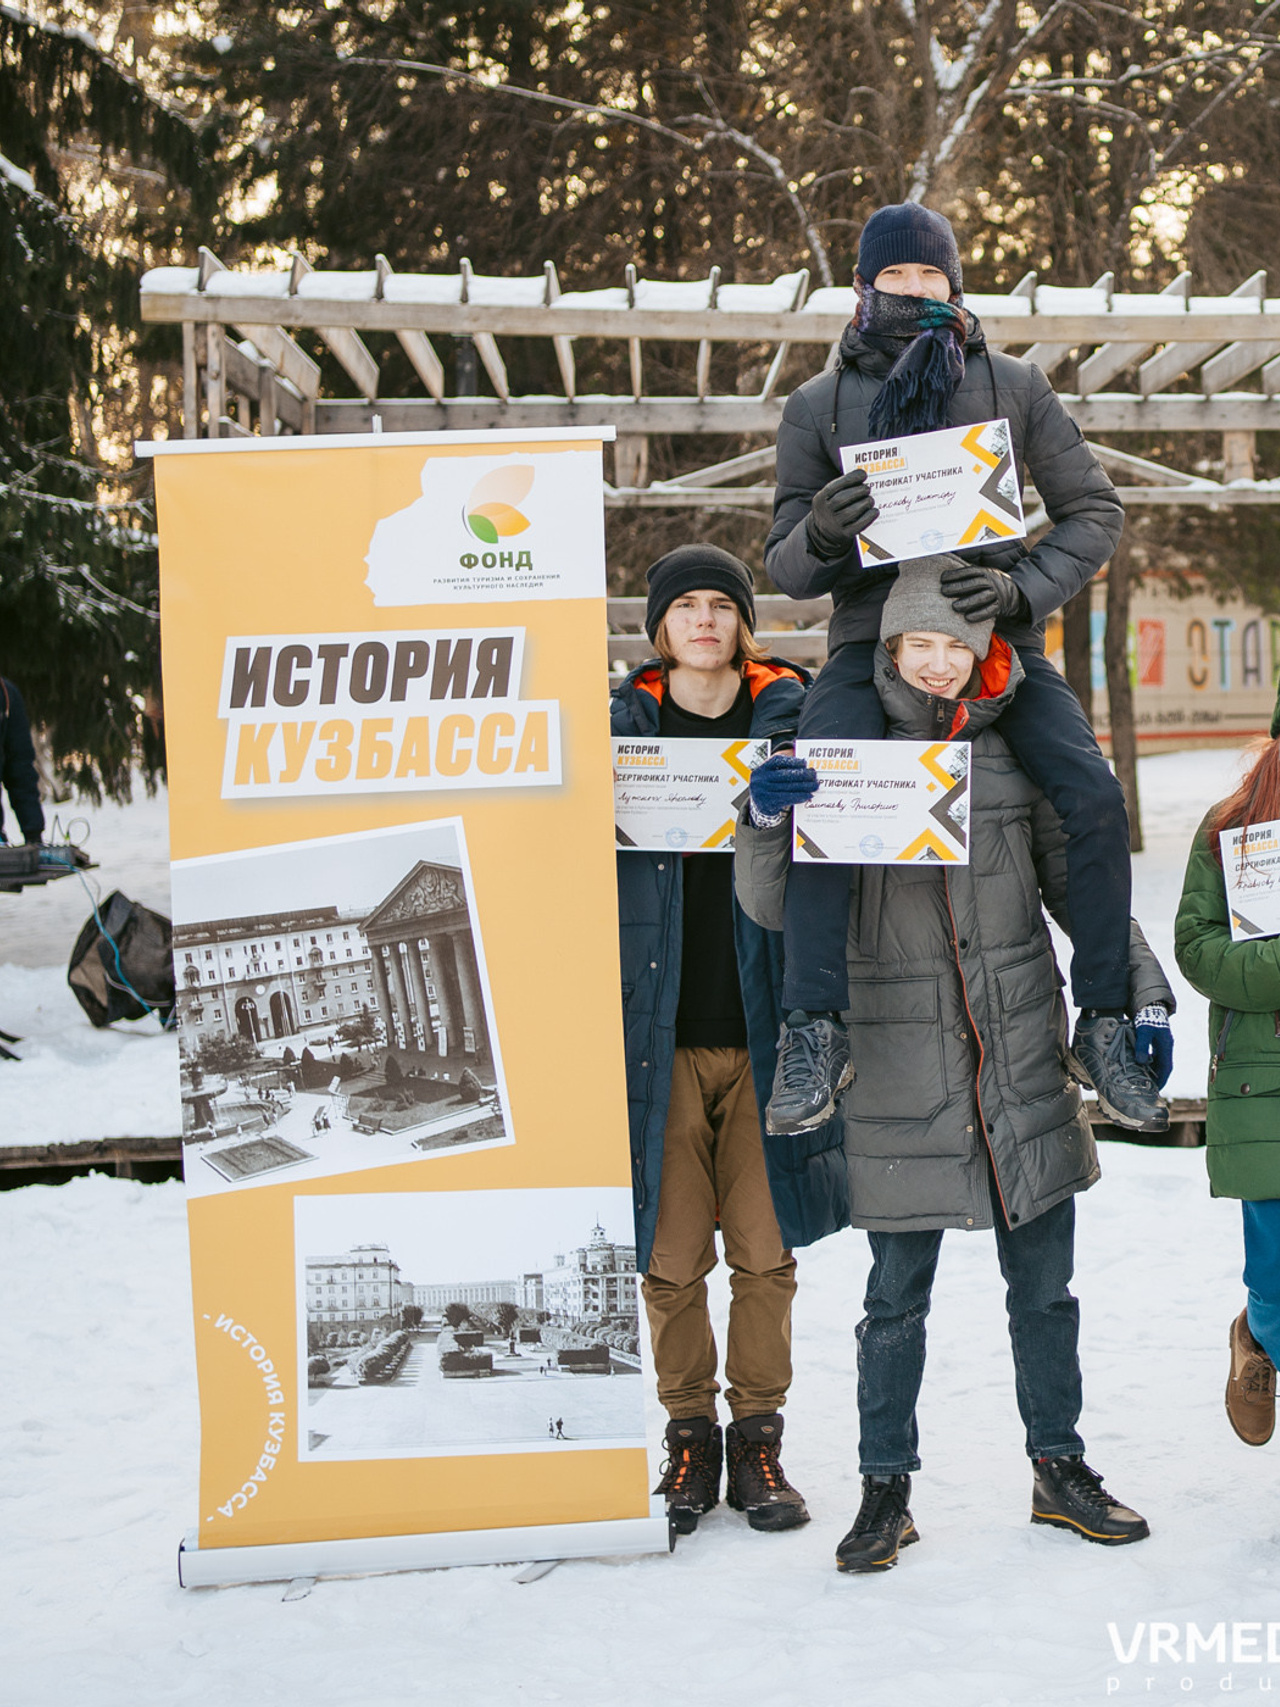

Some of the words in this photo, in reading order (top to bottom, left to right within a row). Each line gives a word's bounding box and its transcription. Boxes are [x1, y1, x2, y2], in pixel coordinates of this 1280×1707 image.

[855, 447, 898, 463] ИСТОРИЯ
[864, 475, 913, 489] ЕРТИФИКАТ
[916, 466, 963, 483] УЧАСТНИКА
[460, 551, 533, 571] ФОНД
[229, 636, 514, 709] ИСТОРИЯ
[233, 711, 549, 786] КУЗБАССА
[618, 745, 660, 754] ИСТОРИЯ
[809, 748, 853, 758] ИСТОРИЯ
[618, 756, 665, 766] КУЗБАССА
[617, 774, 670, 782] СЕРТИФИКАТ
[818, 780, 863, 788] РТИФИКАТ
[867, 780, 916, 789] УЧАСТНИКА
[1233, 829, 1272, 845] ИСТОРИЯ
[214, 1314, 284, 1405] ИСТОРИЯ
[218, 1412, 285, 1518] КУЗБАССА
